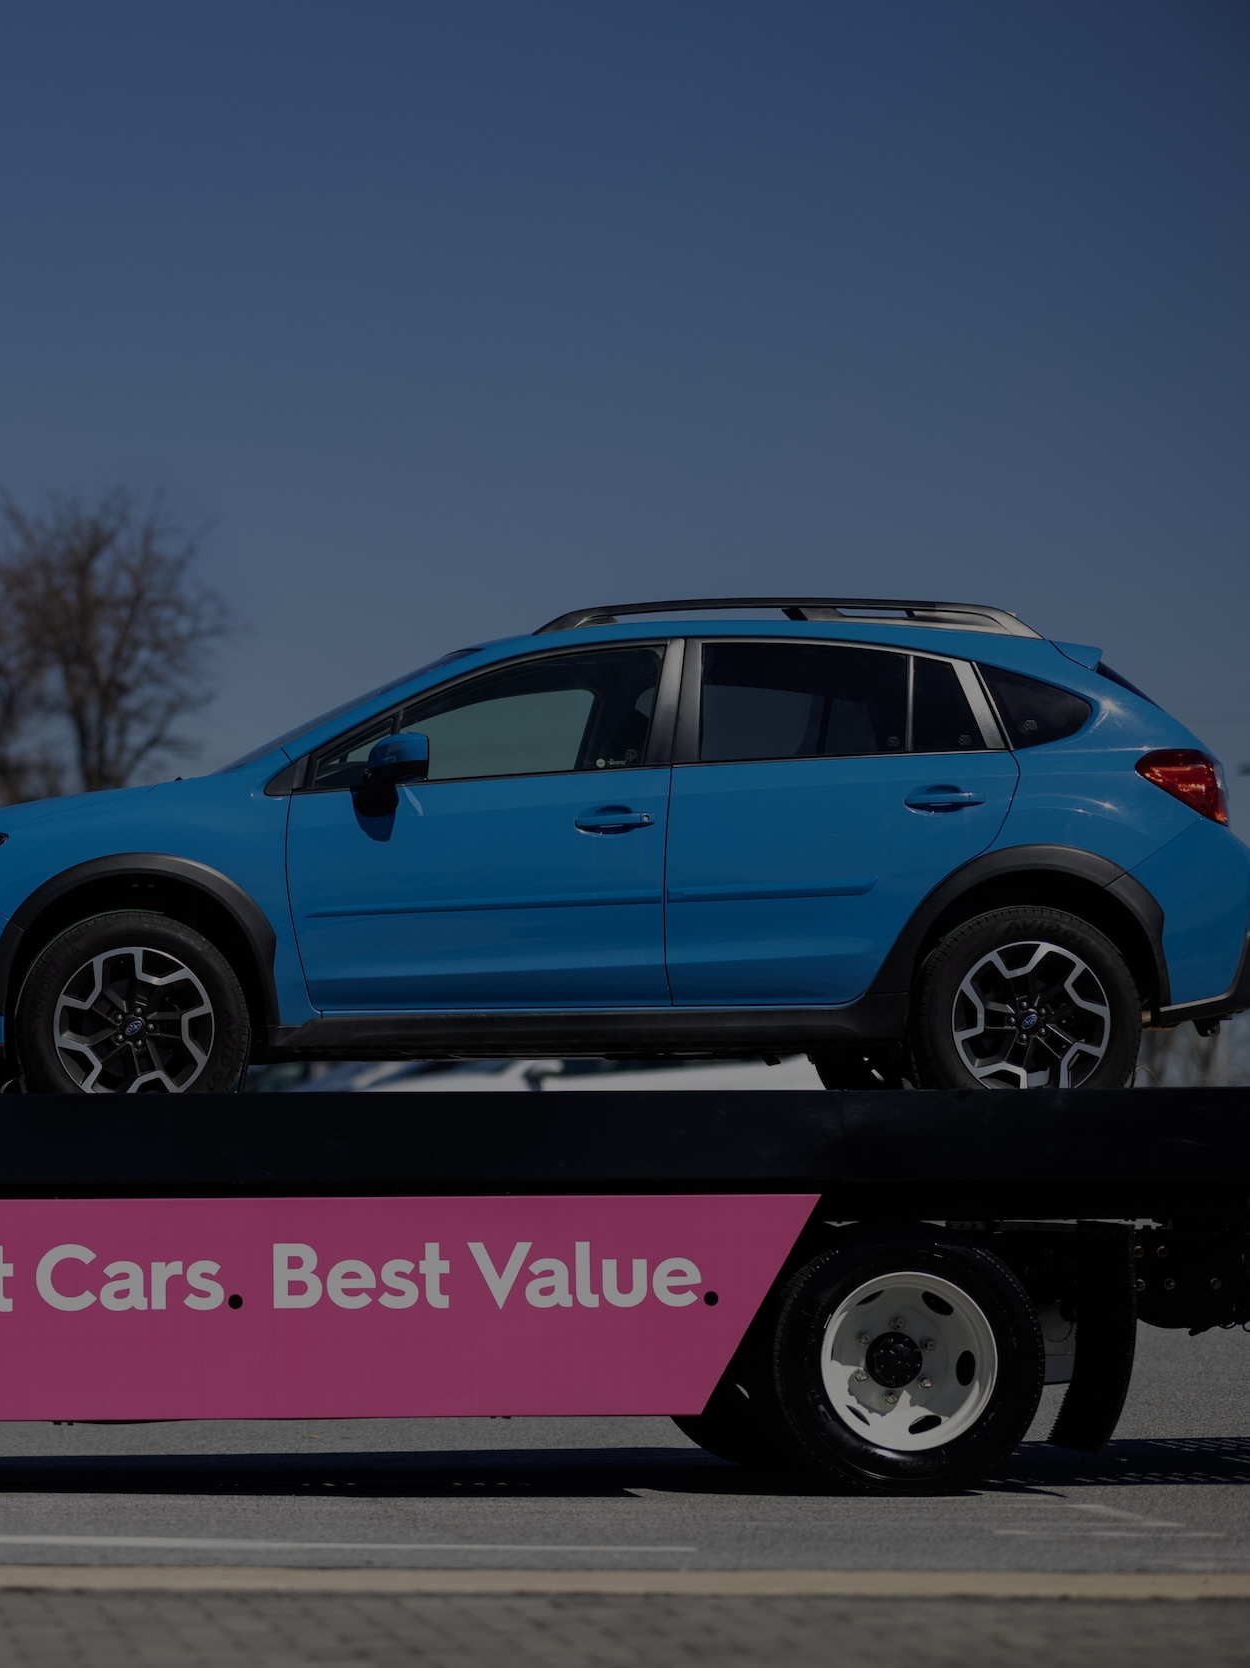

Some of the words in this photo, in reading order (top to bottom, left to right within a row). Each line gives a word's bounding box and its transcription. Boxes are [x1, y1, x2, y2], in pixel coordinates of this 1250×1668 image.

[1003, 920, 1062, 937] AVID
[33, 946, 83, 1019] YOKOHAMA
[36, 1244, 243, 1311] Cars.
[273, 1243, 449, 1309] Best
[468, 1241, 718, 1309] Value.
